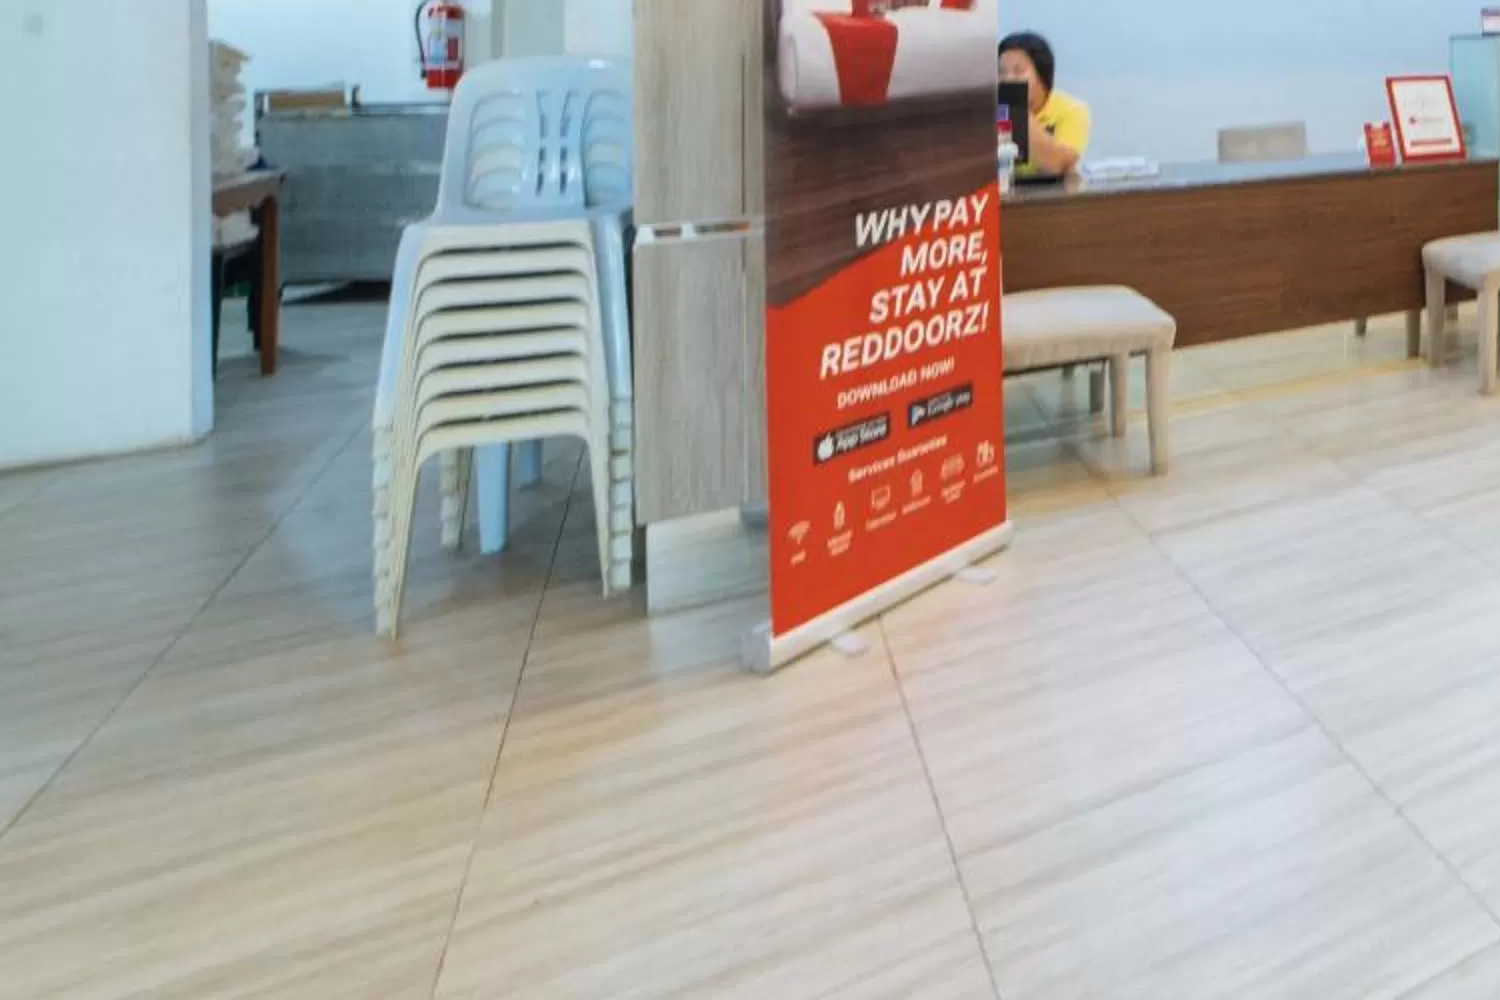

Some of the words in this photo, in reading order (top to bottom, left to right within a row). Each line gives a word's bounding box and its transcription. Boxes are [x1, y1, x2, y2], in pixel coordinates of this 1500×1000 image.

[855, 203, 931, 247] WHY
[932, 193, 989, 233] PAY
[901, 230, 988, 278] MORE,
[869, 275, 945, 324] STAY
[949, 266, 988, 303] AT
[819, 302, 990, 380] REDDOORZ!
[837, 368, 918, 410] DOWNLOAD
[921, 357, 956, 381] NOW!
